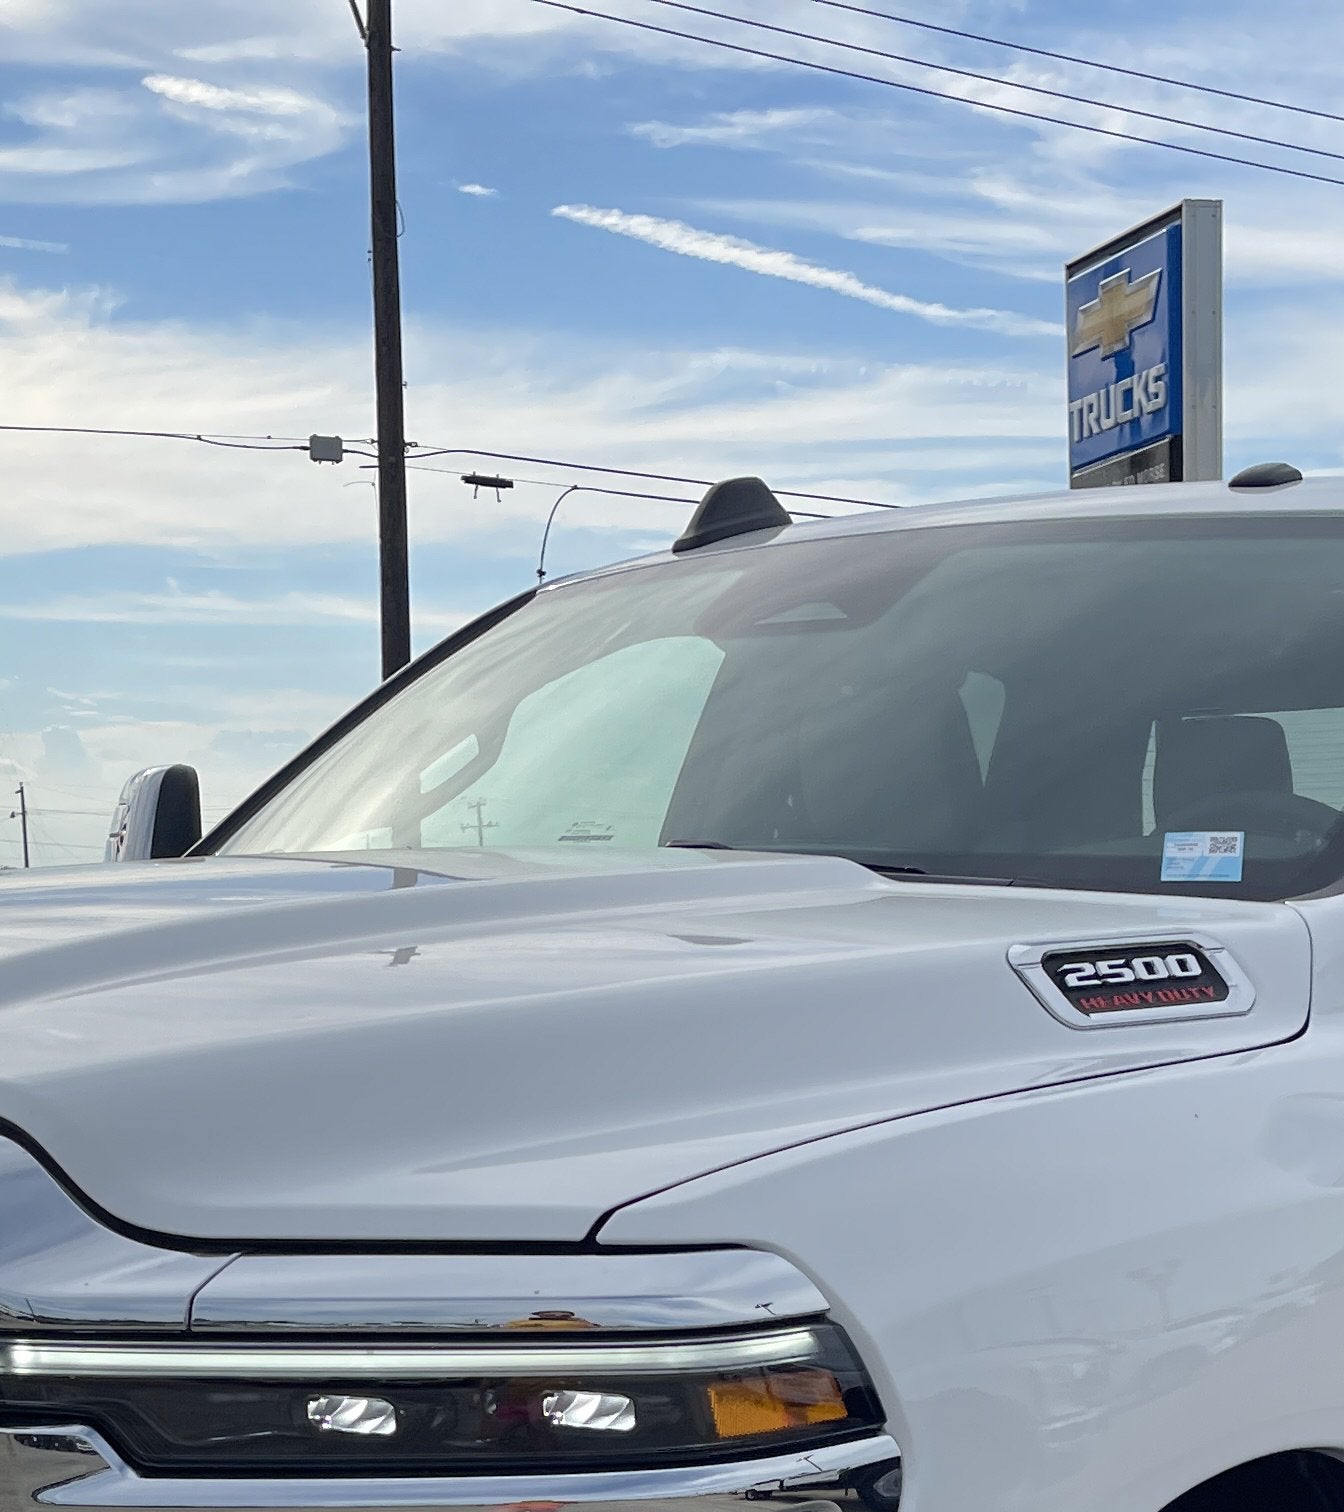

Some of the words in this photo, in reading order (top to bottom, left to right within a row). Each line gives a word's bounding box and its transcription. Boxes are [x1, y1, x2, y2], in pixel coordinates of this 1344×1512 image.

[1069, 362, 1168, 443] TRUCKS
[1057, 953, 1202, 987] 2500
[1080, 990, 1154, 1010] HEAVY
[1157, 986, 1215, 1003] DUTY
